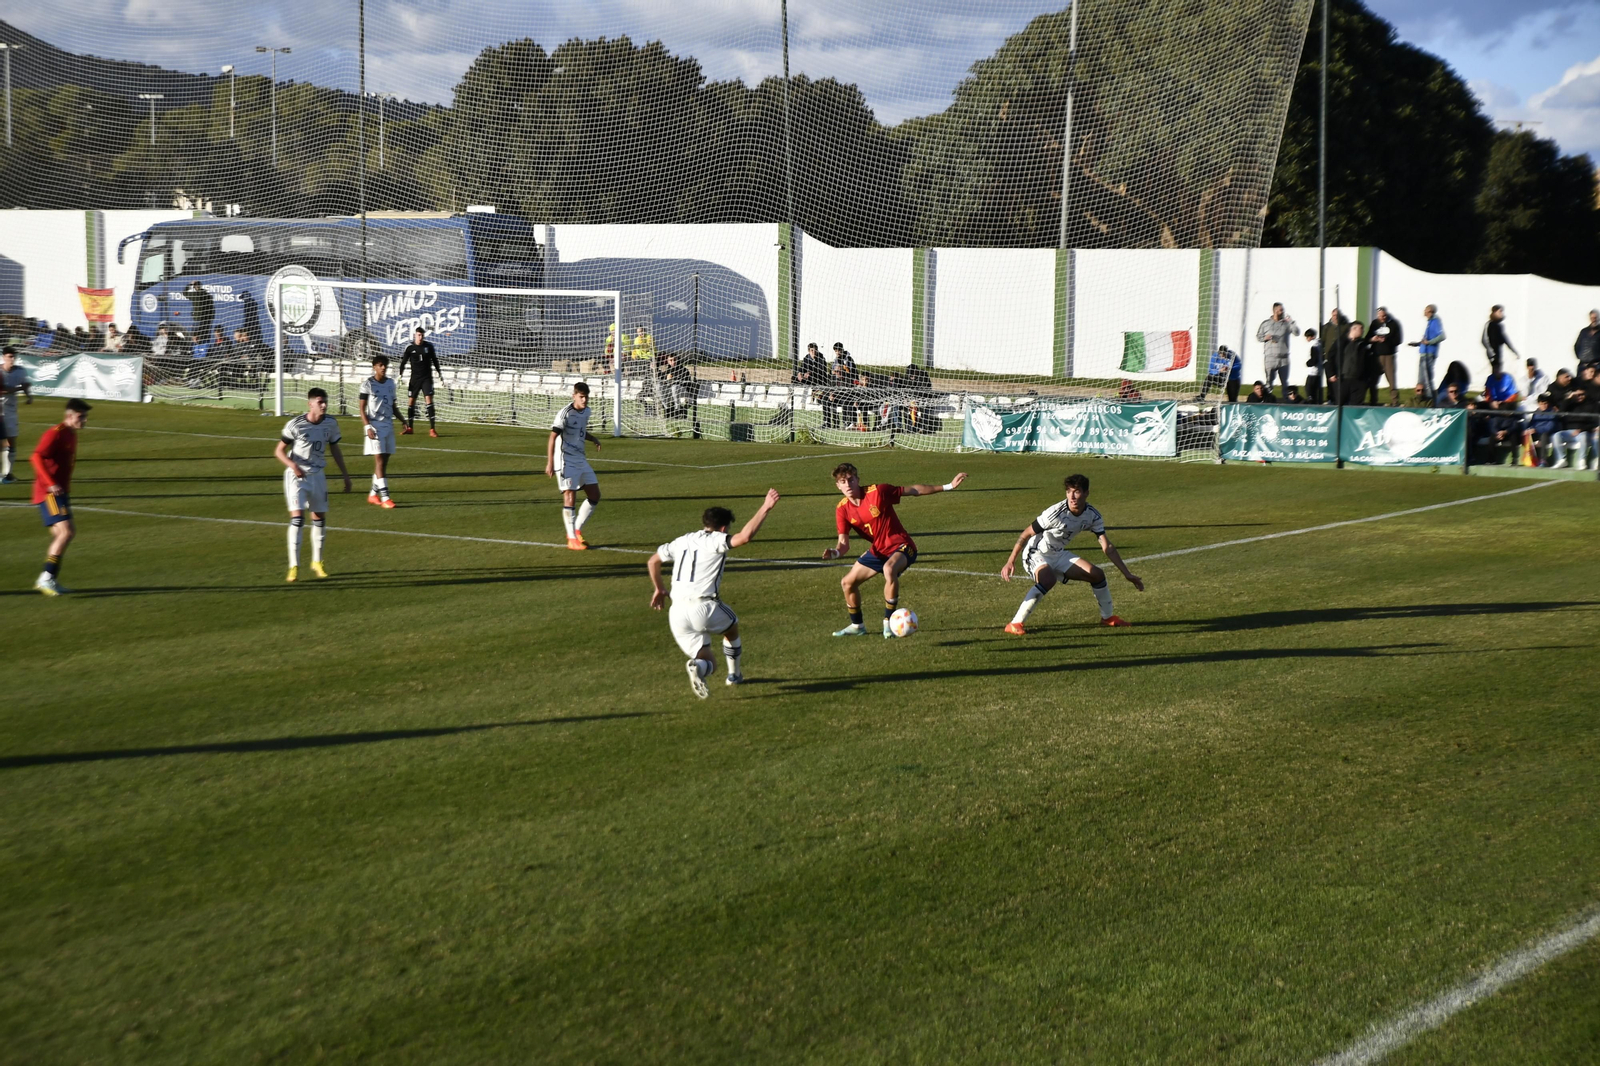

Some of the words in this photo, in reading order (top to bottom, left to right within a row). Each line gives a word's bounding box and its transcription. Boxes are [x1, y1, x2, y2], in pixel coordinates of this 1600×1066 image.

[383, 395, 389, 405] 5
[1282, 412, 1304, 420] PACO
[580, 427, 584, 437] 6
[312, 441, 322, 451] 10
[864, 523, 873, 535] 7
[676, 549, 698, 582] 11
